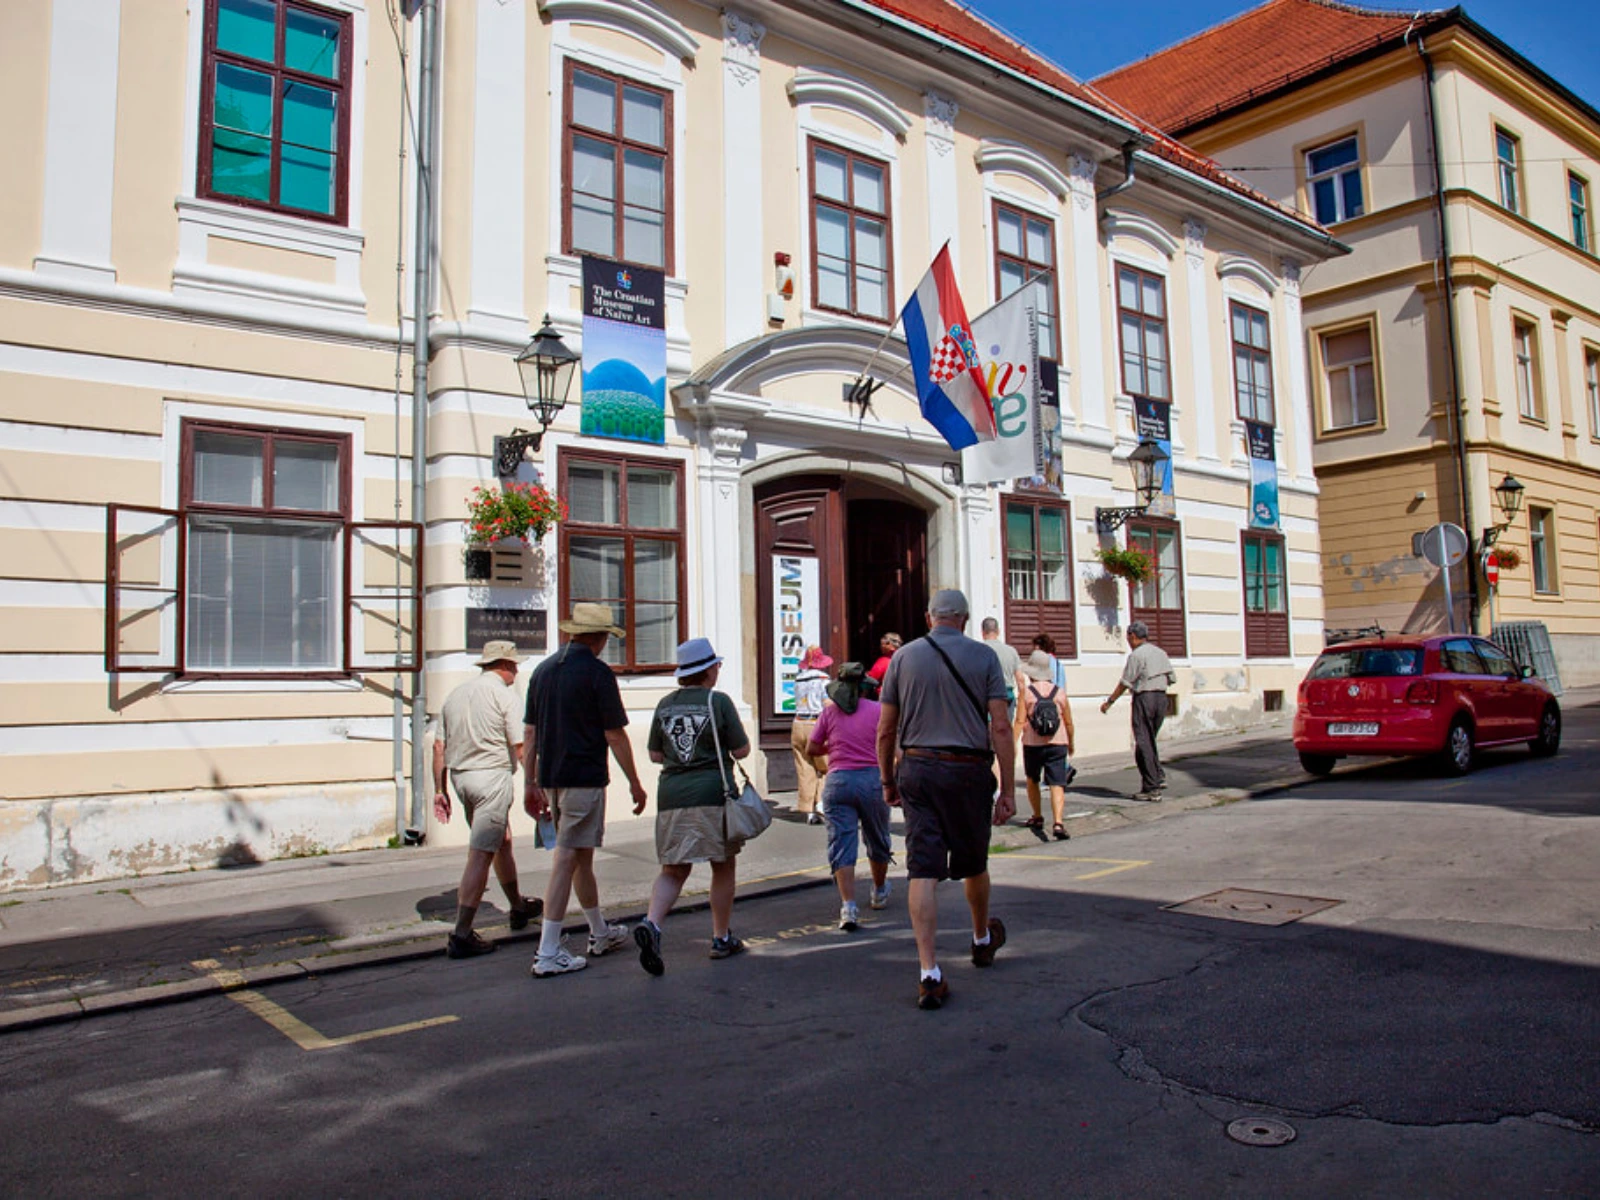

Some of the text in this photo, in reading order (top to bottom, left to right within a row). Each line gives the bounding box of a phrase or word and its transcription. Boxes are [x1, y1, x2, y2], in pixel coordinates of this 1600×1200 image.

[592, 284, 655, 306] The Croatian
[592, 294, 634, 311] Museum
[592, 307, 603, 315] of
[635, 314, 651, 325] Art
[780, 558, 803, 712] MUSEUM
